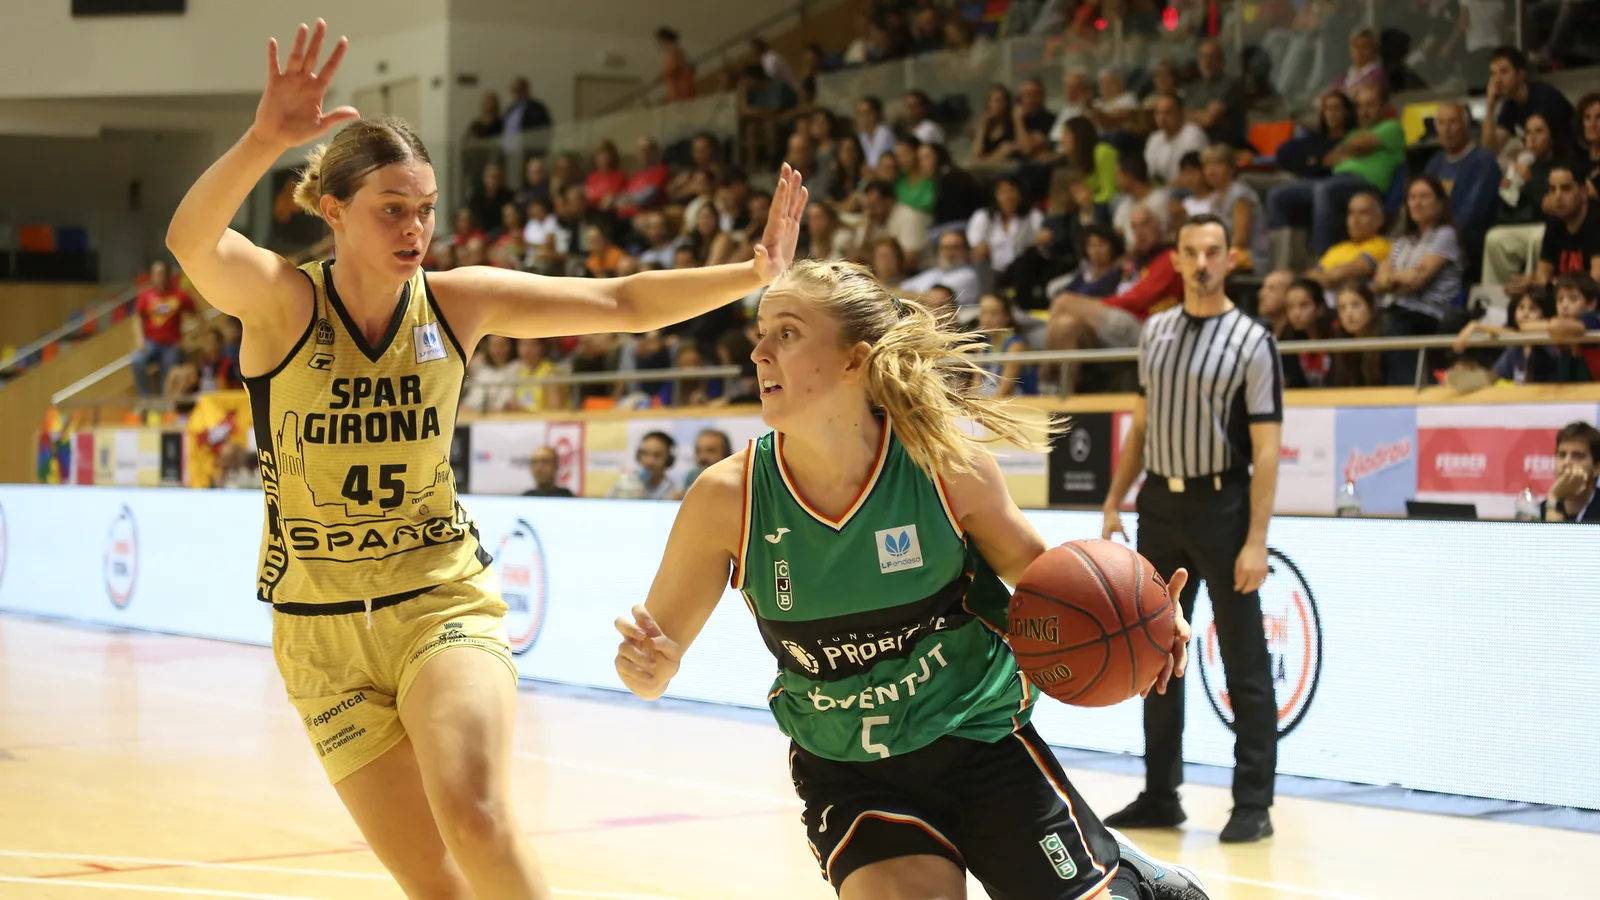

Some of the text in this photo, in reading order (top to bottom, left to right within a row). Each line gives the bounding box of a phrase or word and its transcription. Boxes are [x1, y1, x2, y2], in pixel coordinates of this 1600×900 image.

[329, 374, 422, 410] SPAR
[303, 406, 441, 445] GIRONA
[341, 463, 408, 509] 45
[313, 690, 368, 728] esportcat
[322, 723, 356, 748] Generalitat
[325, 726, 367, 754] de Catalunya
